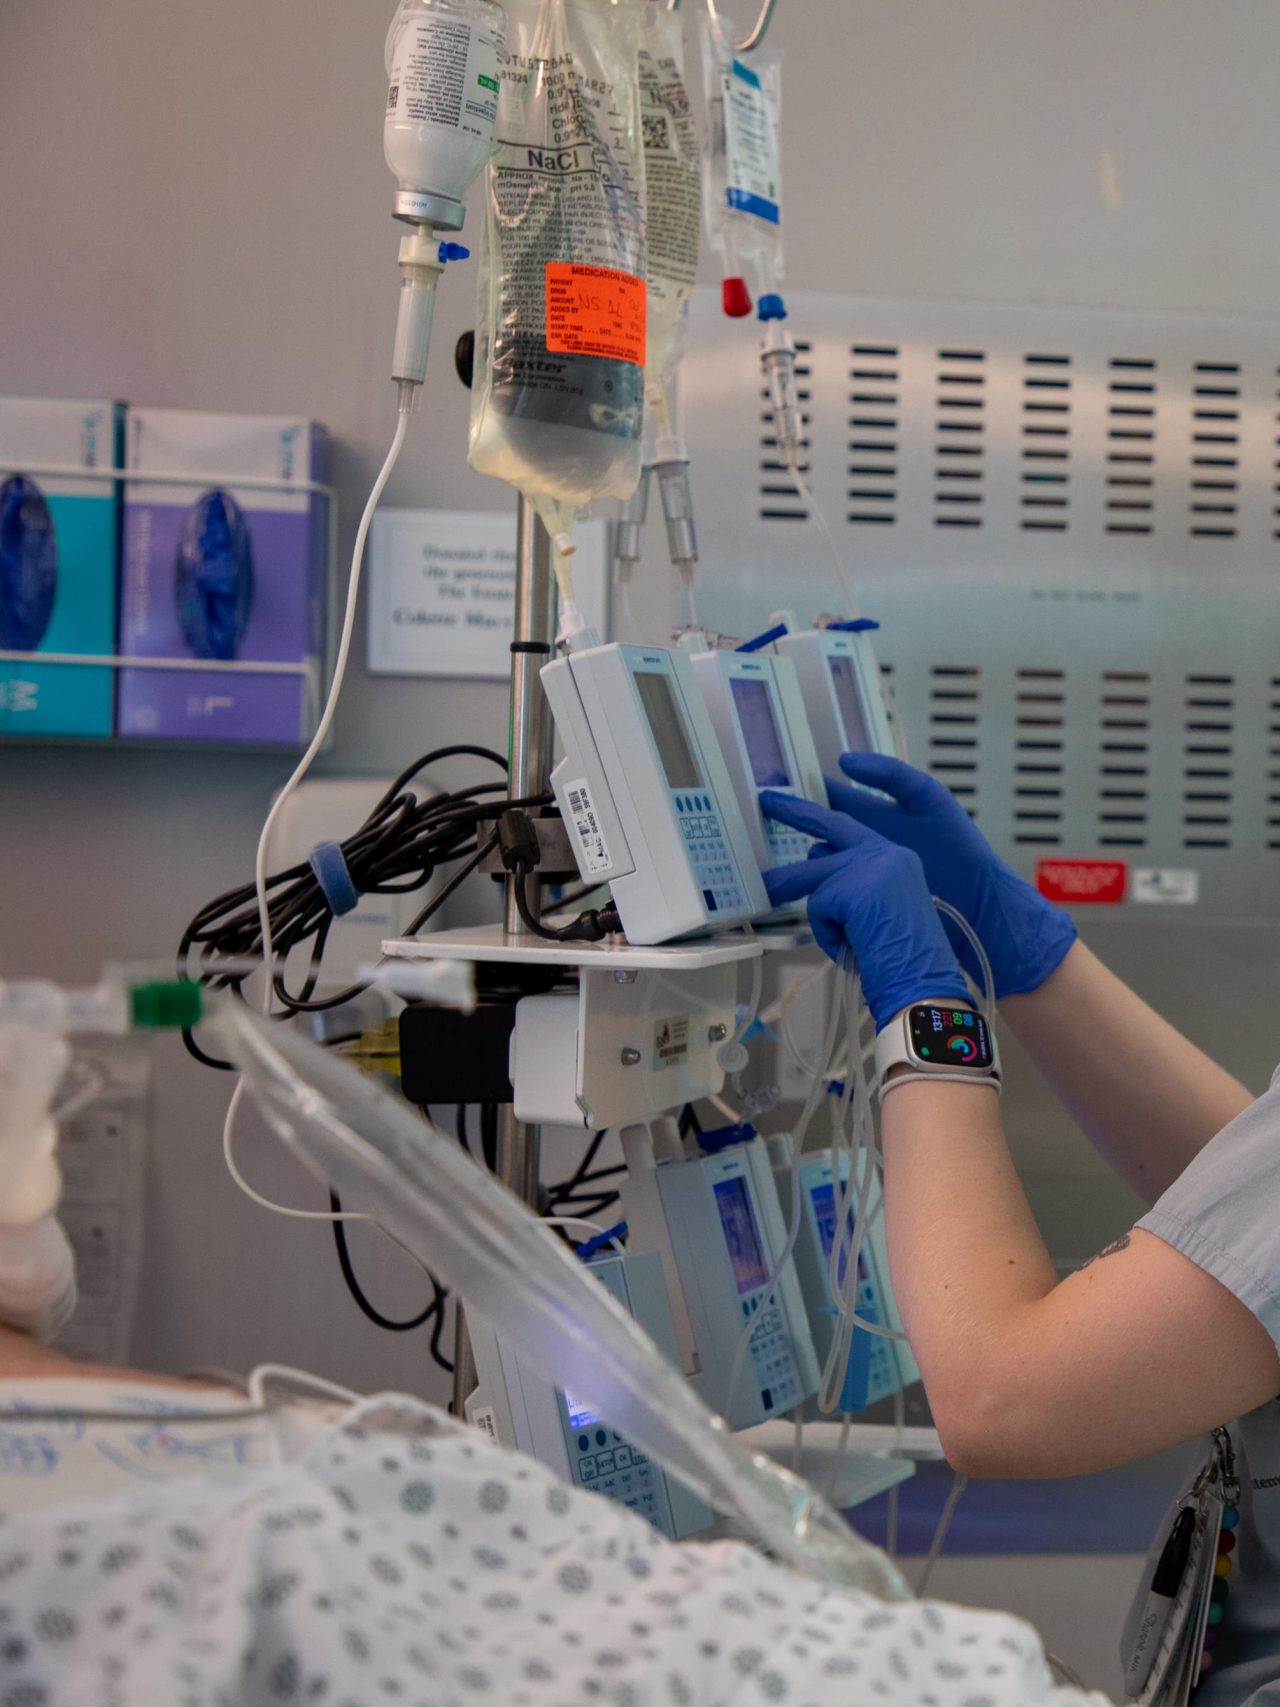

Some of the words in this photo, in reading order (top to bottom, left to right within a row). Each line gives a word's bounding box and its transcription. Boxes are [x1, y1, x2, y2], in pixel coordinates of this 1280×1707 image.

[528, 150, 579, 171] NaCl
[571, 267, 620, 280] MEDICATION
[550, 278, 572, 286] PATIENT
[931, 1010, 943, 1032] 13:17
[952, 1012, 963, 1025] 09
